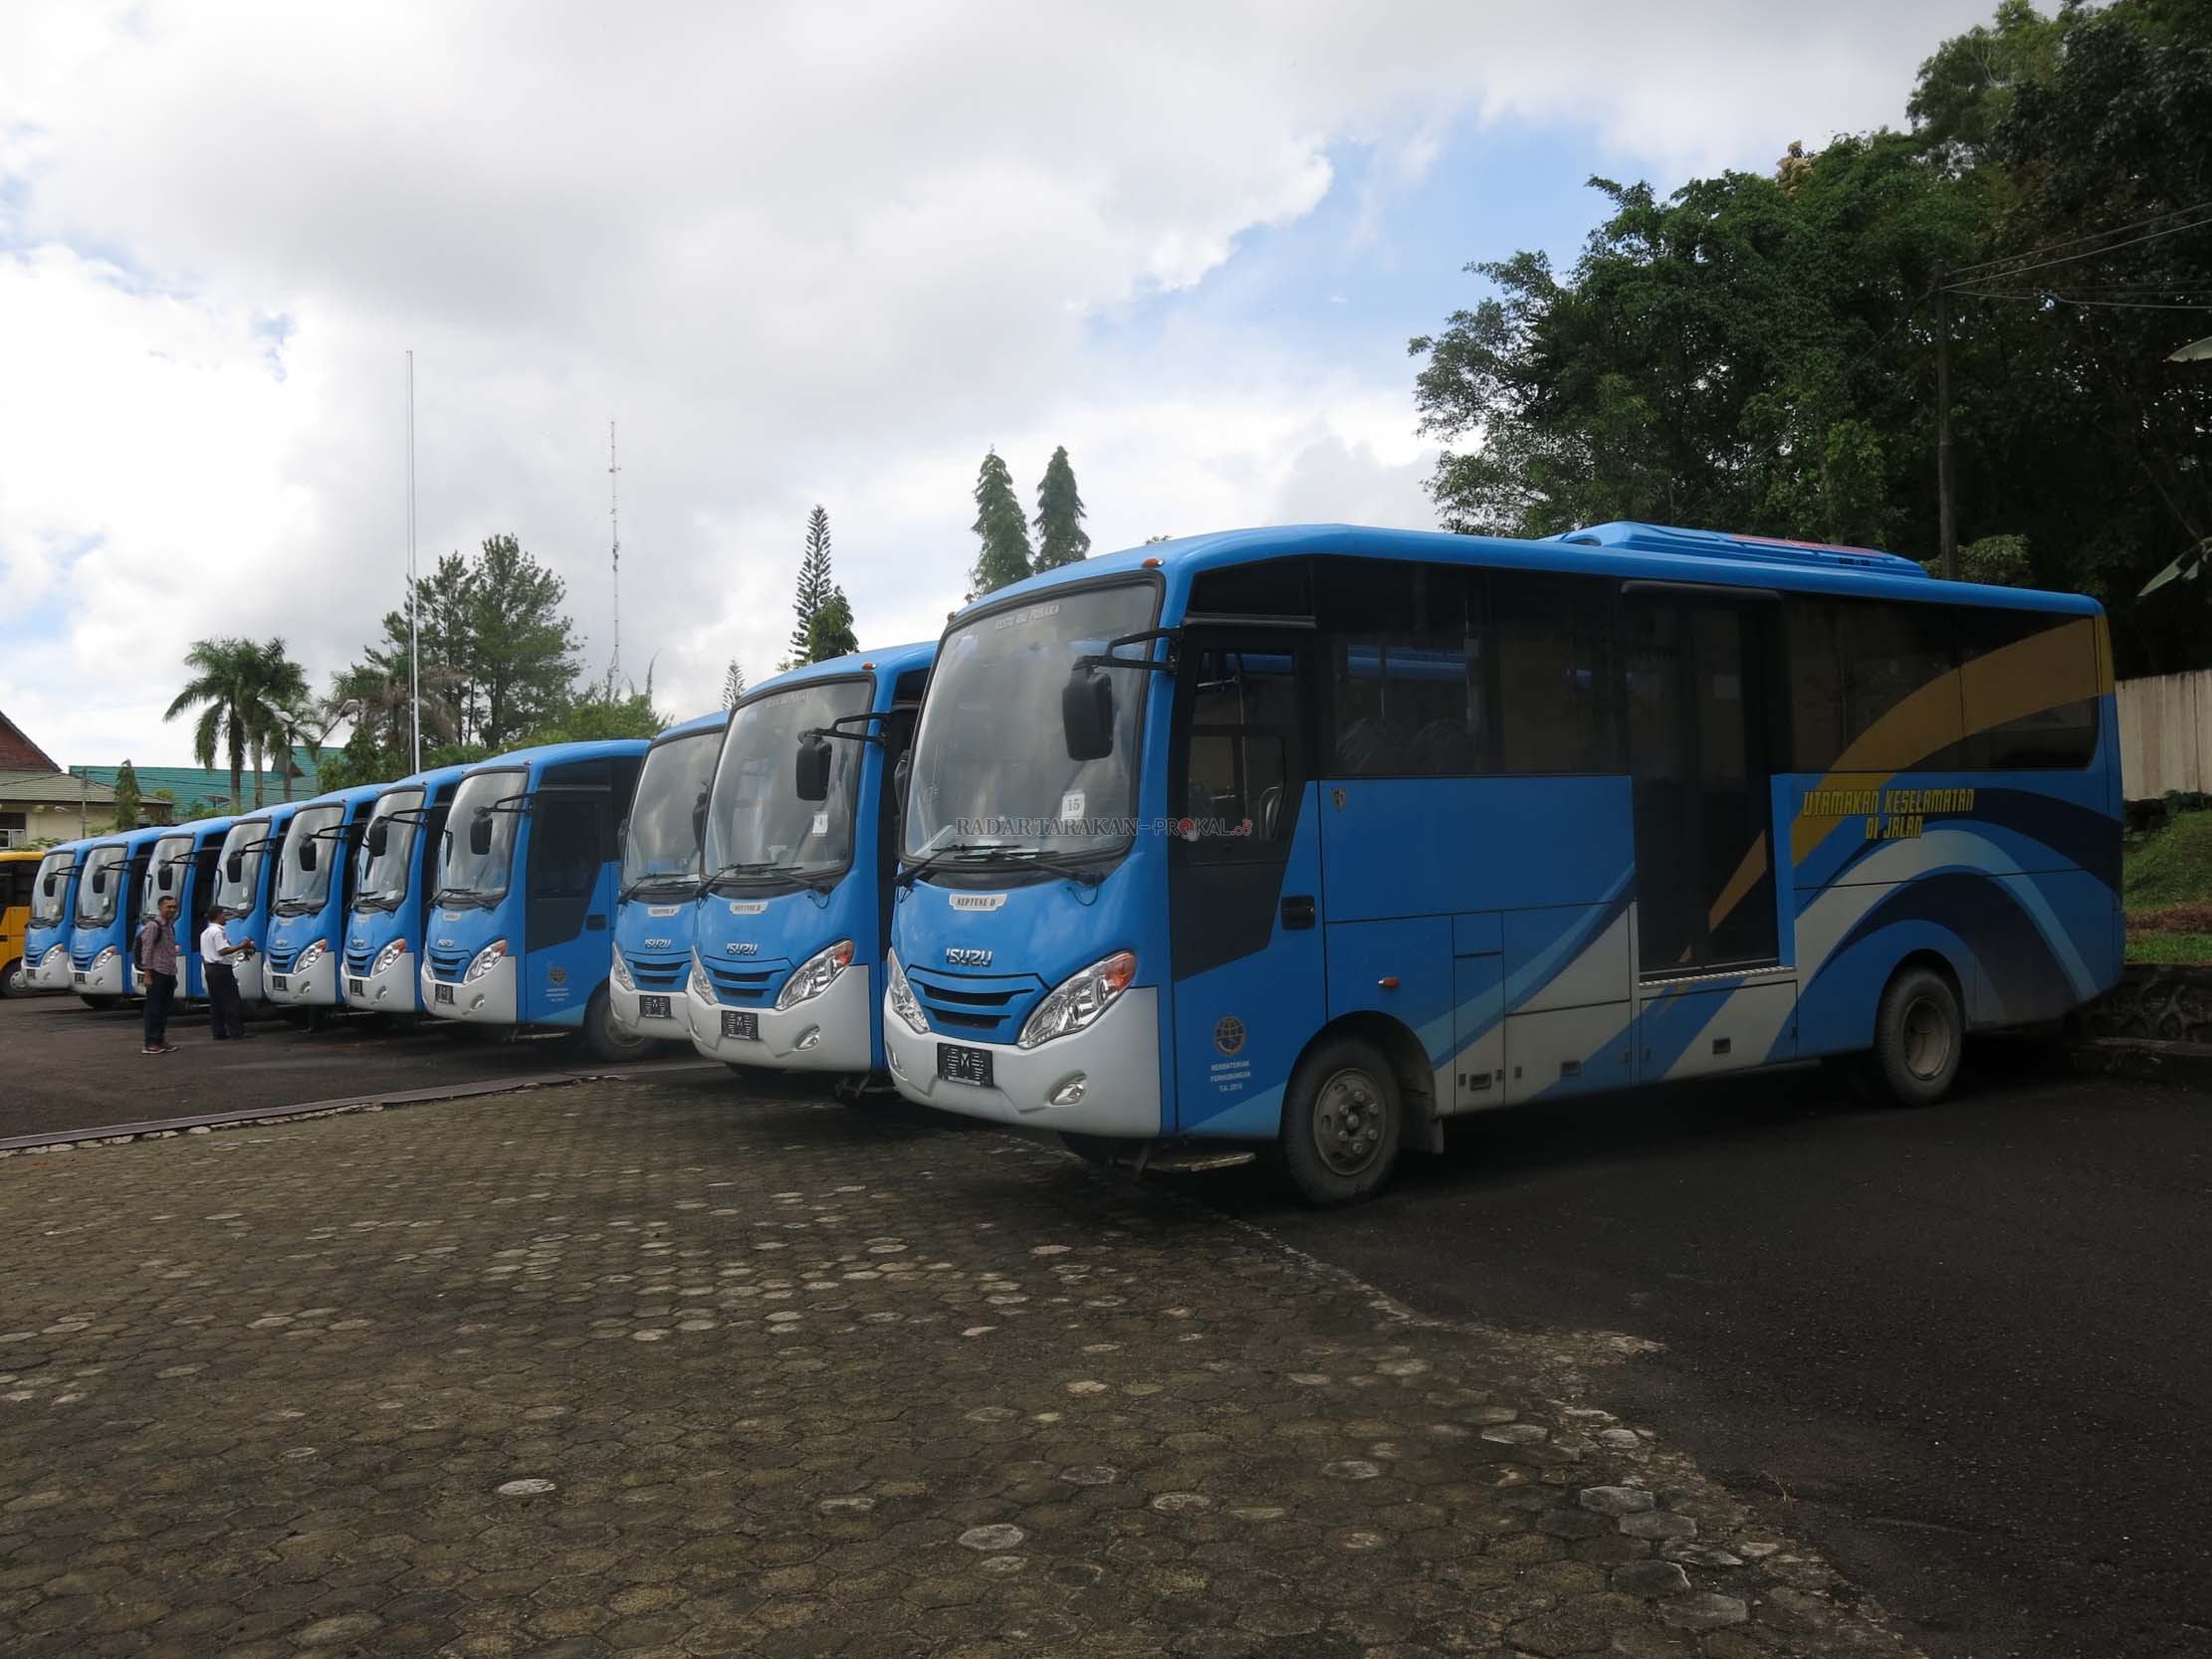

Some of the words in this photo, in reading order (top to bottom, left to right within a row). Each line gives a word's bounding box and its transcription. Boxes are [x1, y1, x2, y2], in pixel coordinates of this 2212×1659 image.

[1067, 798, 1080, 811] 15
[1803, 790, 1880, 815] UTAMAKAN
[1885, 788, 1975, 813] KESELAMATAN
[1865, 816, 1880, 839] DI
[1883, 815, 1923, 838] JALAN
[727, 942, 758, 955] ISUZU
[946, 947, 994, 966] ISUZU
